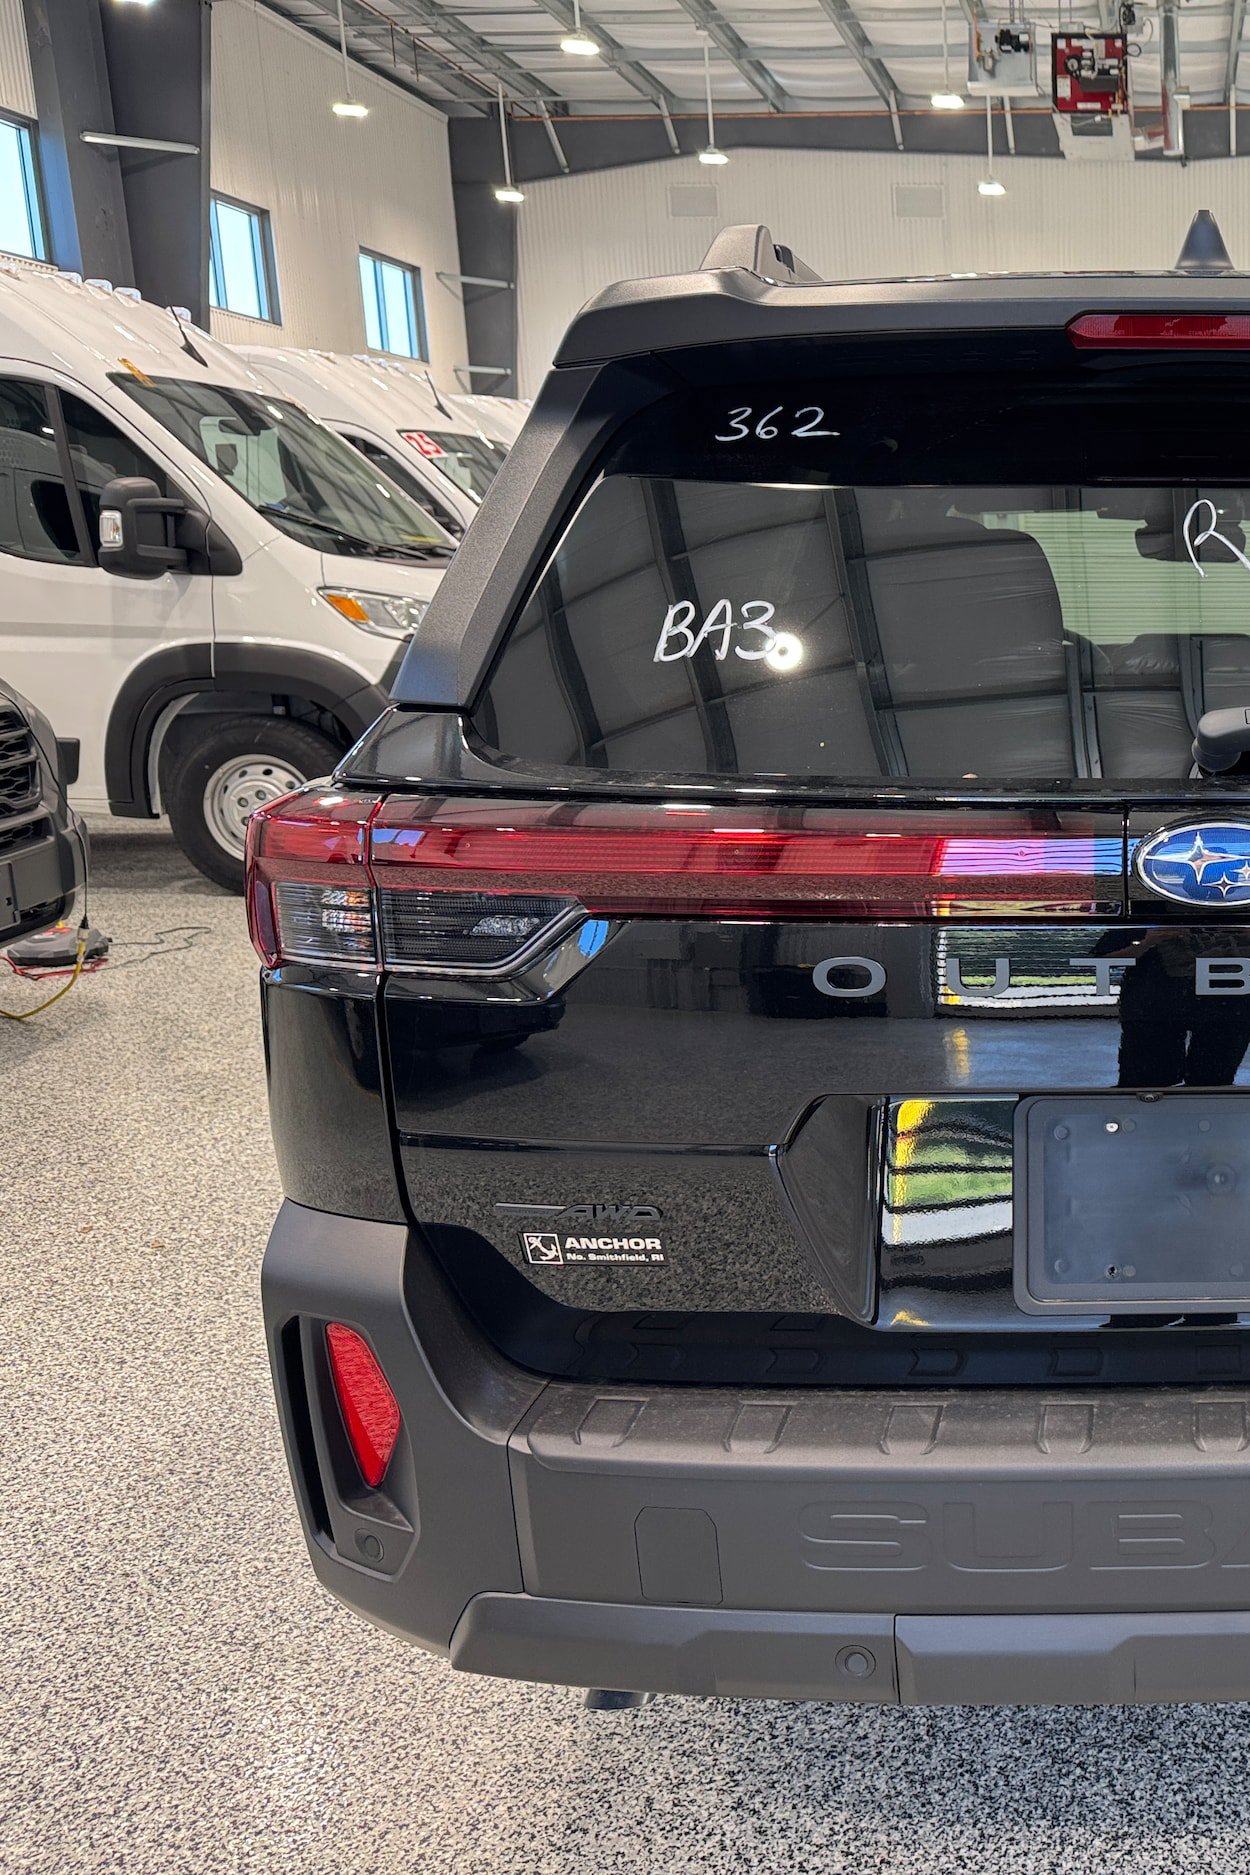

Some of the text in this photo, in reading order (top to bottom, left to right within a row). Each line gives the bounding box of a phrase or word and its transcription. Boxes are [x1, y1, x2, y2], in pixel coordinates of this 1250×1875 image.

[715, 406, 841, 441] 362
[653, 599, 776, 662] BA3
[556, 1204, 663, 1219] AWD
[565, 1237, 662, 1250] ANCHOR
[566, 1253, 664, 1262] No. Smithfield, RI
